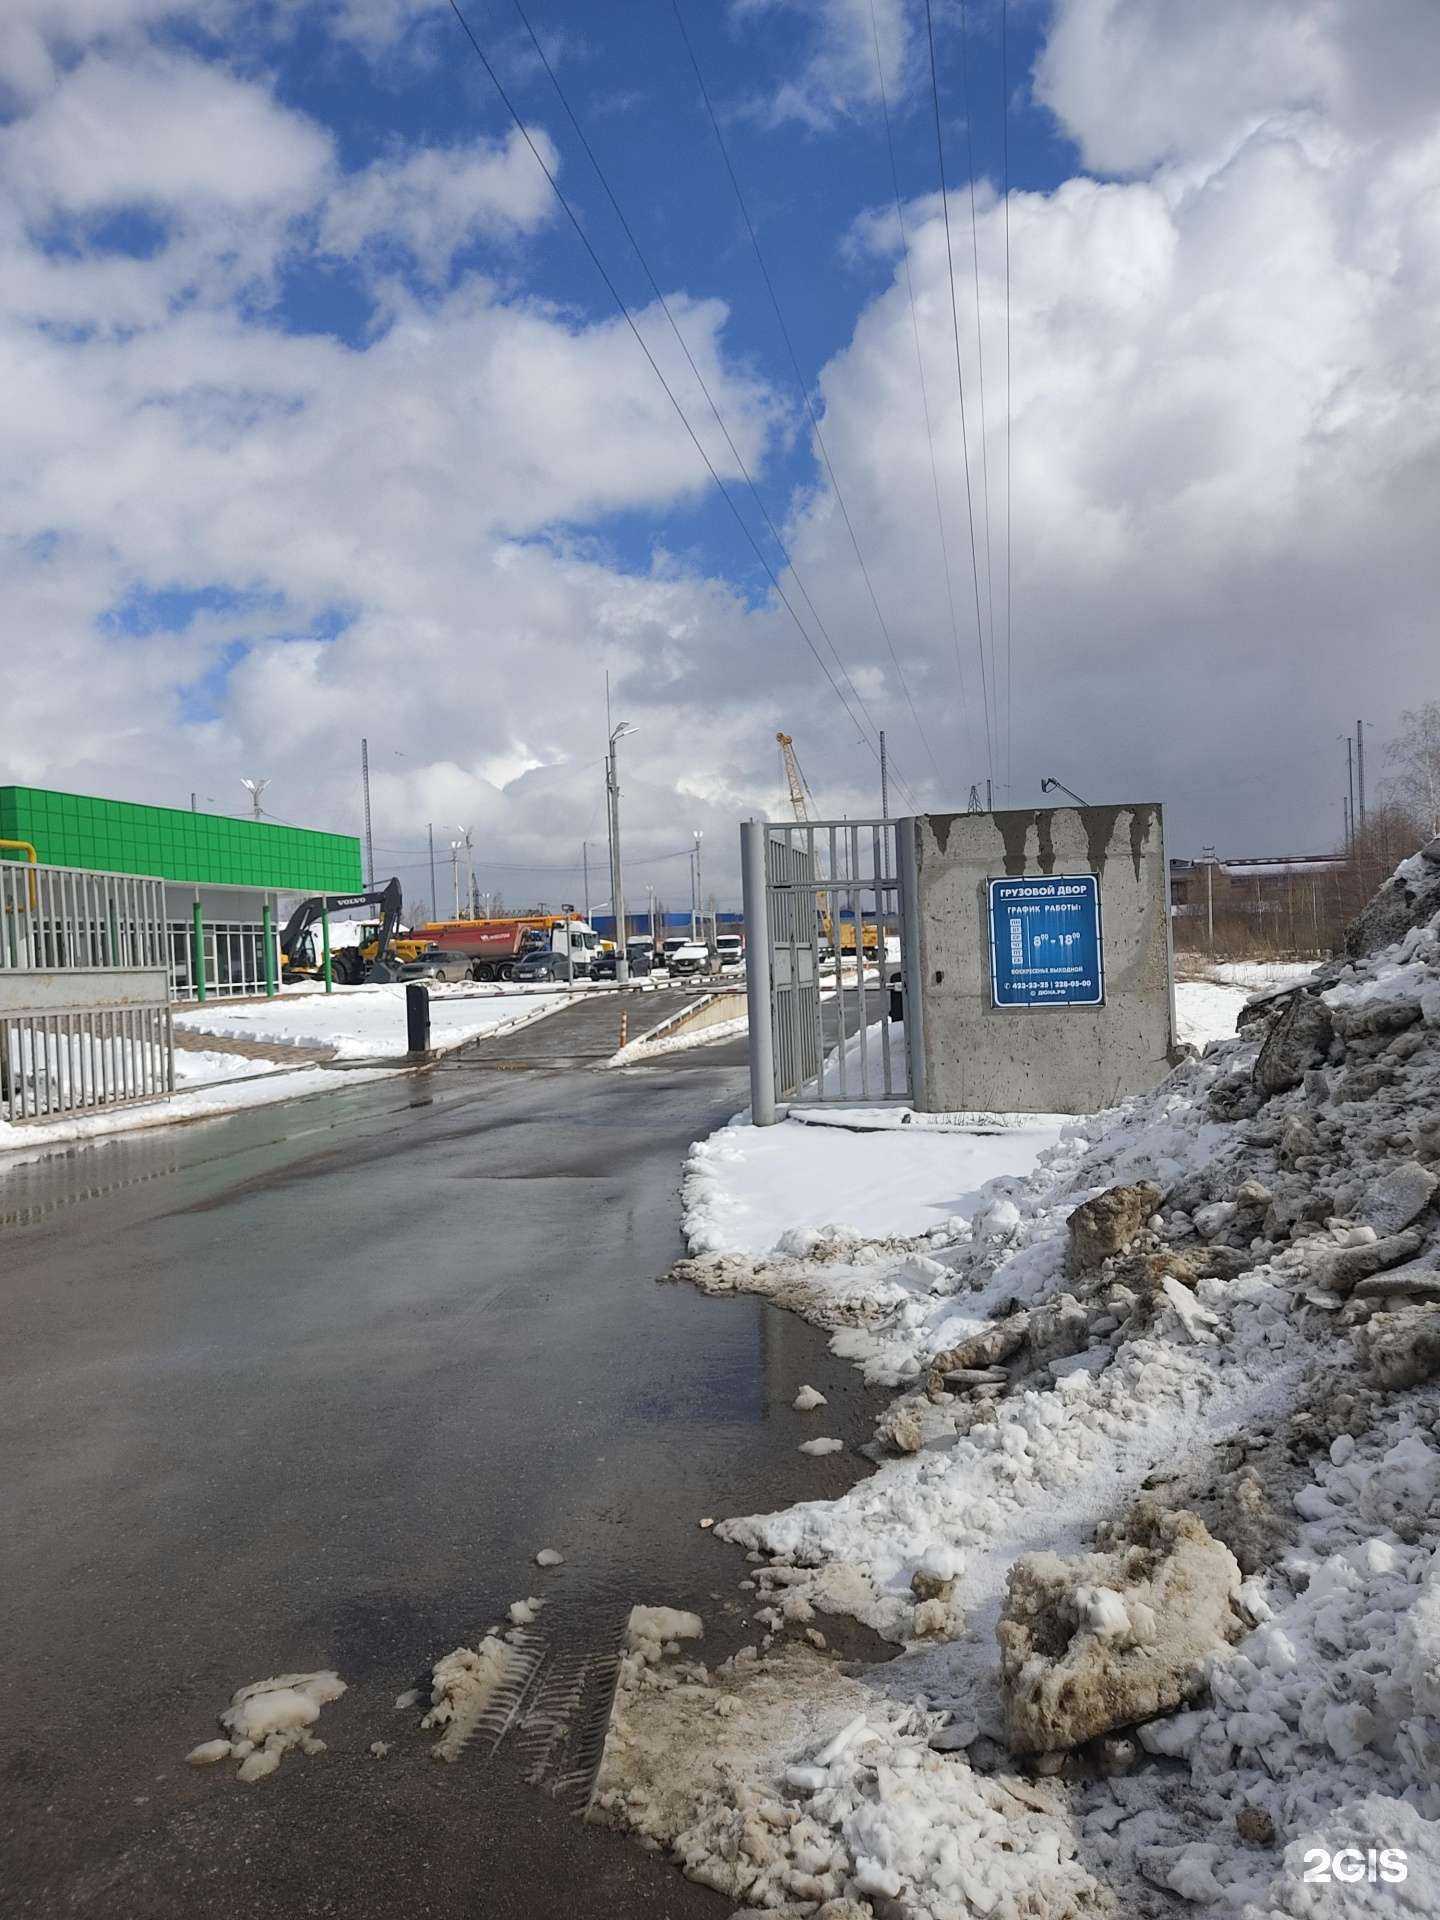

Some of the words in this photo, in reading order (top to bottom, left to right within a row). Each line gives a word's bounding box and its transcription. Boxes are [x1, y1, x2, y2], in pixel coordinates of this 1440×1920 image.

[1000, 885, 1055, 898] ГРУЗОВОЙ
[1057, 885, 1087, 895] ДВОР
[337, 897, 366, 906] VOLVO
